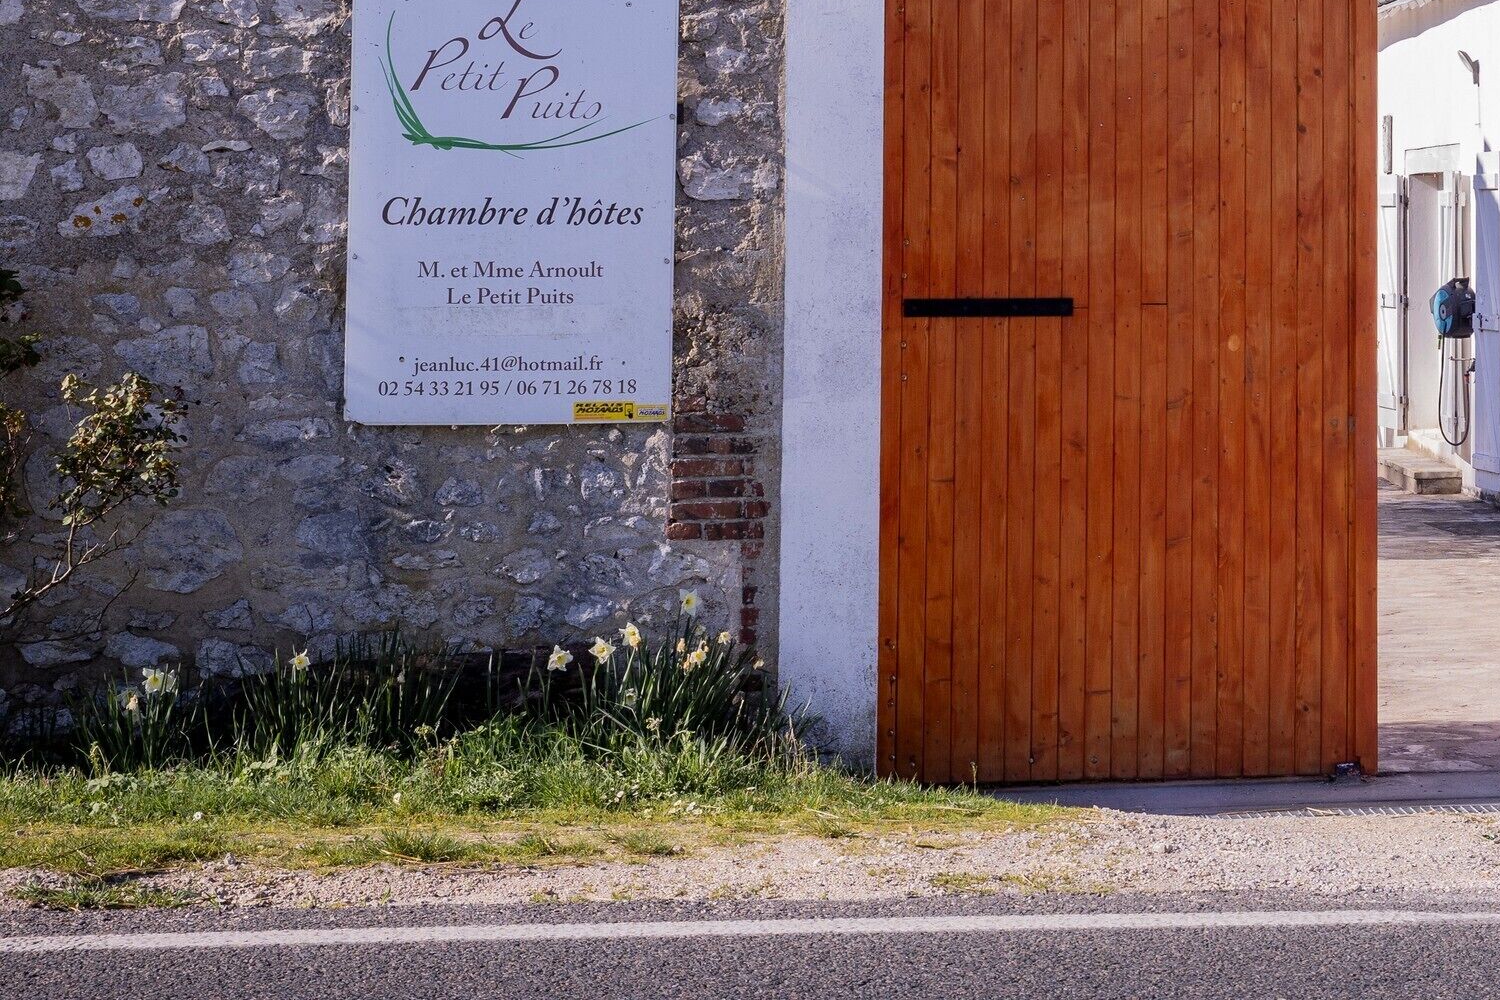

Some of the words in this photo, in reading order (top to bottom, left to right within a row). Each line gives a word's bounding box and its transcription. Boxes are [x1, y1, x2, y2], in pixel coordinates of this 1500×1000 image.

[410, 37, 509, 91] Petit
[501, 65, 602, 120] Puits
[381, 196, 528, 226] Chambre
[536, 196, 644, 226] d’hôtes
[417, 260, 445, 278] M.
[451, 264, 468, 278] et
[473, 260, 524, 278] Mme
[528, 260, 604, 278] Arnoult
[447, 287, 471, 304] Le
[477, 287, 521, 304] Petit
[527, 287, 574, 304] Puits
[412, 355, 603, 376] jeanluc.41@hotmail.fr
[378, 381, 398, 396] 02
[403, 381, 424, 396] 54
[429, 381, 449, 396] 33
[454, 380, 473, 395] 21
[480, 380, 499, 395] 95
[505, 380, 512, 395] /
[517, 380, 537, 395] 06
[542, 380, 560, 395] 71
[566, 379, 587, 395] 26
[592, 379, 612, 395] 78
[617, 379, 637, 394] 18
